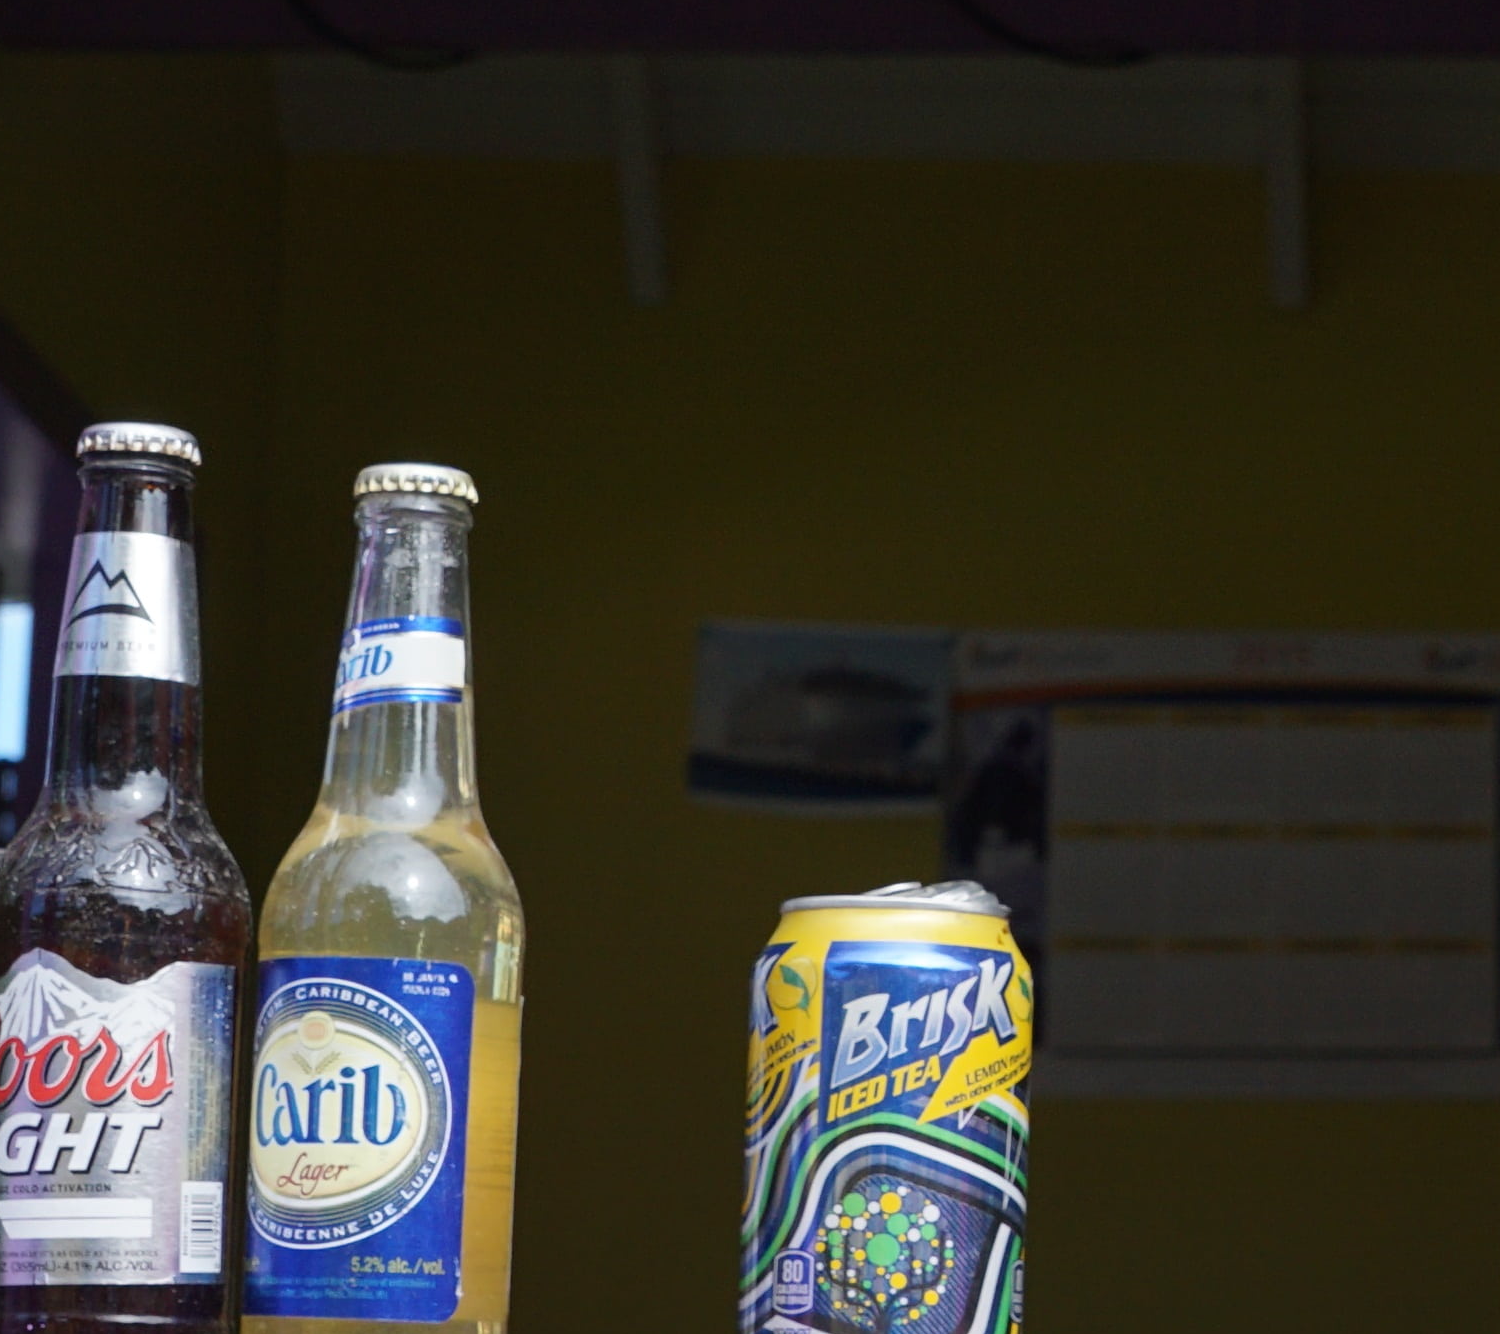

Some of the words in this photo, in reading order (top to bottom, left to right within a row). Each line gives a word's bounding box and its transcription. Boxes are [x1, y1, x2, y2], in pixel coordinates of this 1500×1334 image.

[295, 986, 403, 1027] CARIBBEAN
[406, 1030, 443, 1085] BEER
[827, 1074, 887, 1123] ICED
[891, 1055, 941, 1097] TEA
[966, 1058, 1009, 1086] LEMON
[256, 1063, 407, 1147] Carib
[42, 1183, 112, 1193] ACTIVATION
[277, 1152, 349, 1196] Lager
[368, 1203, 398, 1225] DE
[400, 1150, 440, 1201] LUXE
[351, 1255, 384, 1273] 5.2%
[782, 1259, 804, 1283] 80
